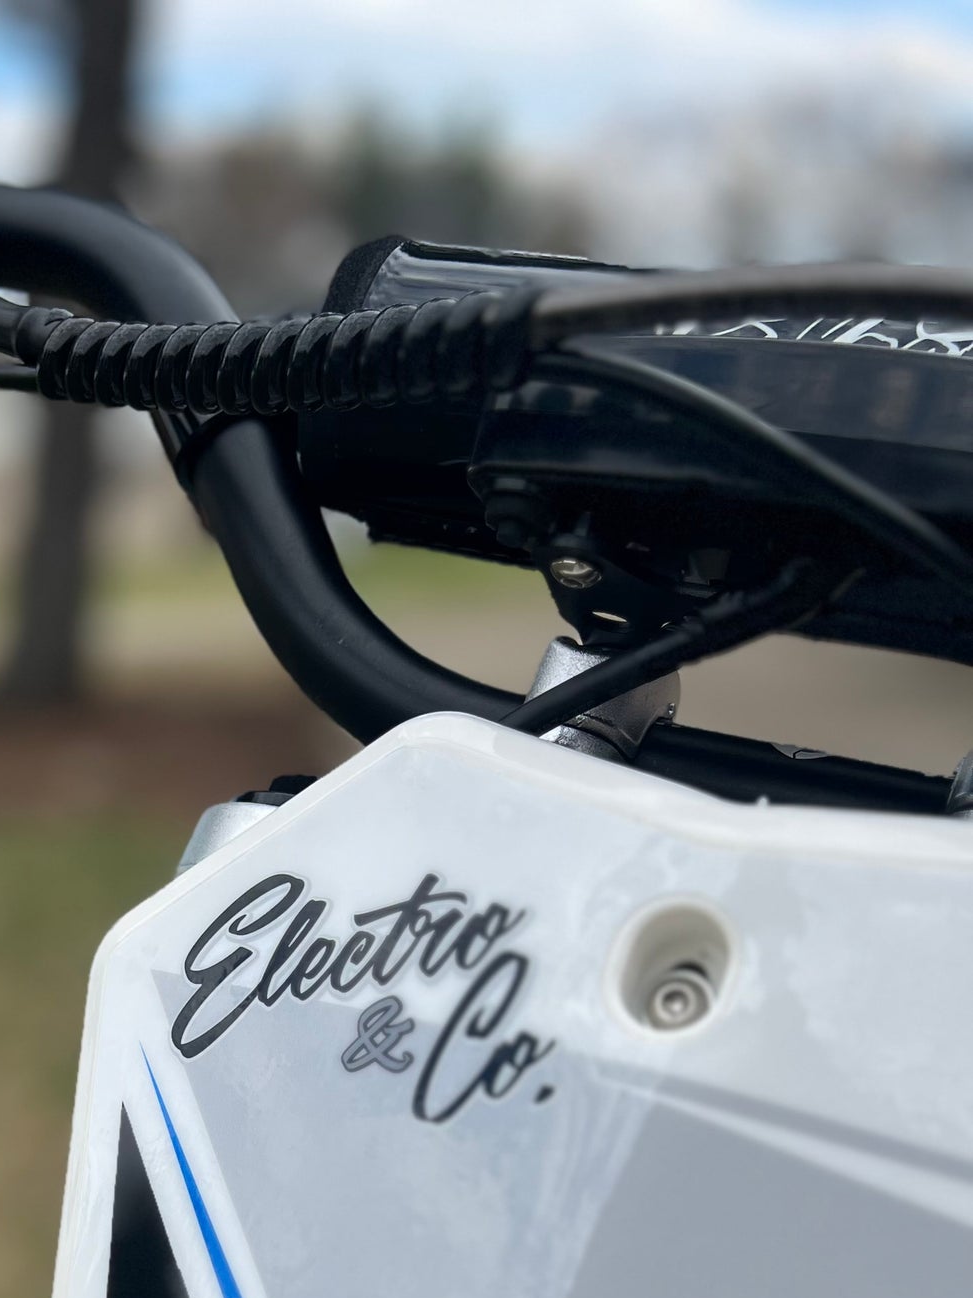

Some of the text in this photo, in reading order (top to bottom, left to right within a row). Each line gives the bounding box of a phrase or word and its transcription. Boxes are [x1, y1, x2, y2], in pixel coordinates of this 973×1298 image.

[170, 873, 526, 1059] Electro
[341, 952, 555, 1124] & Co.
